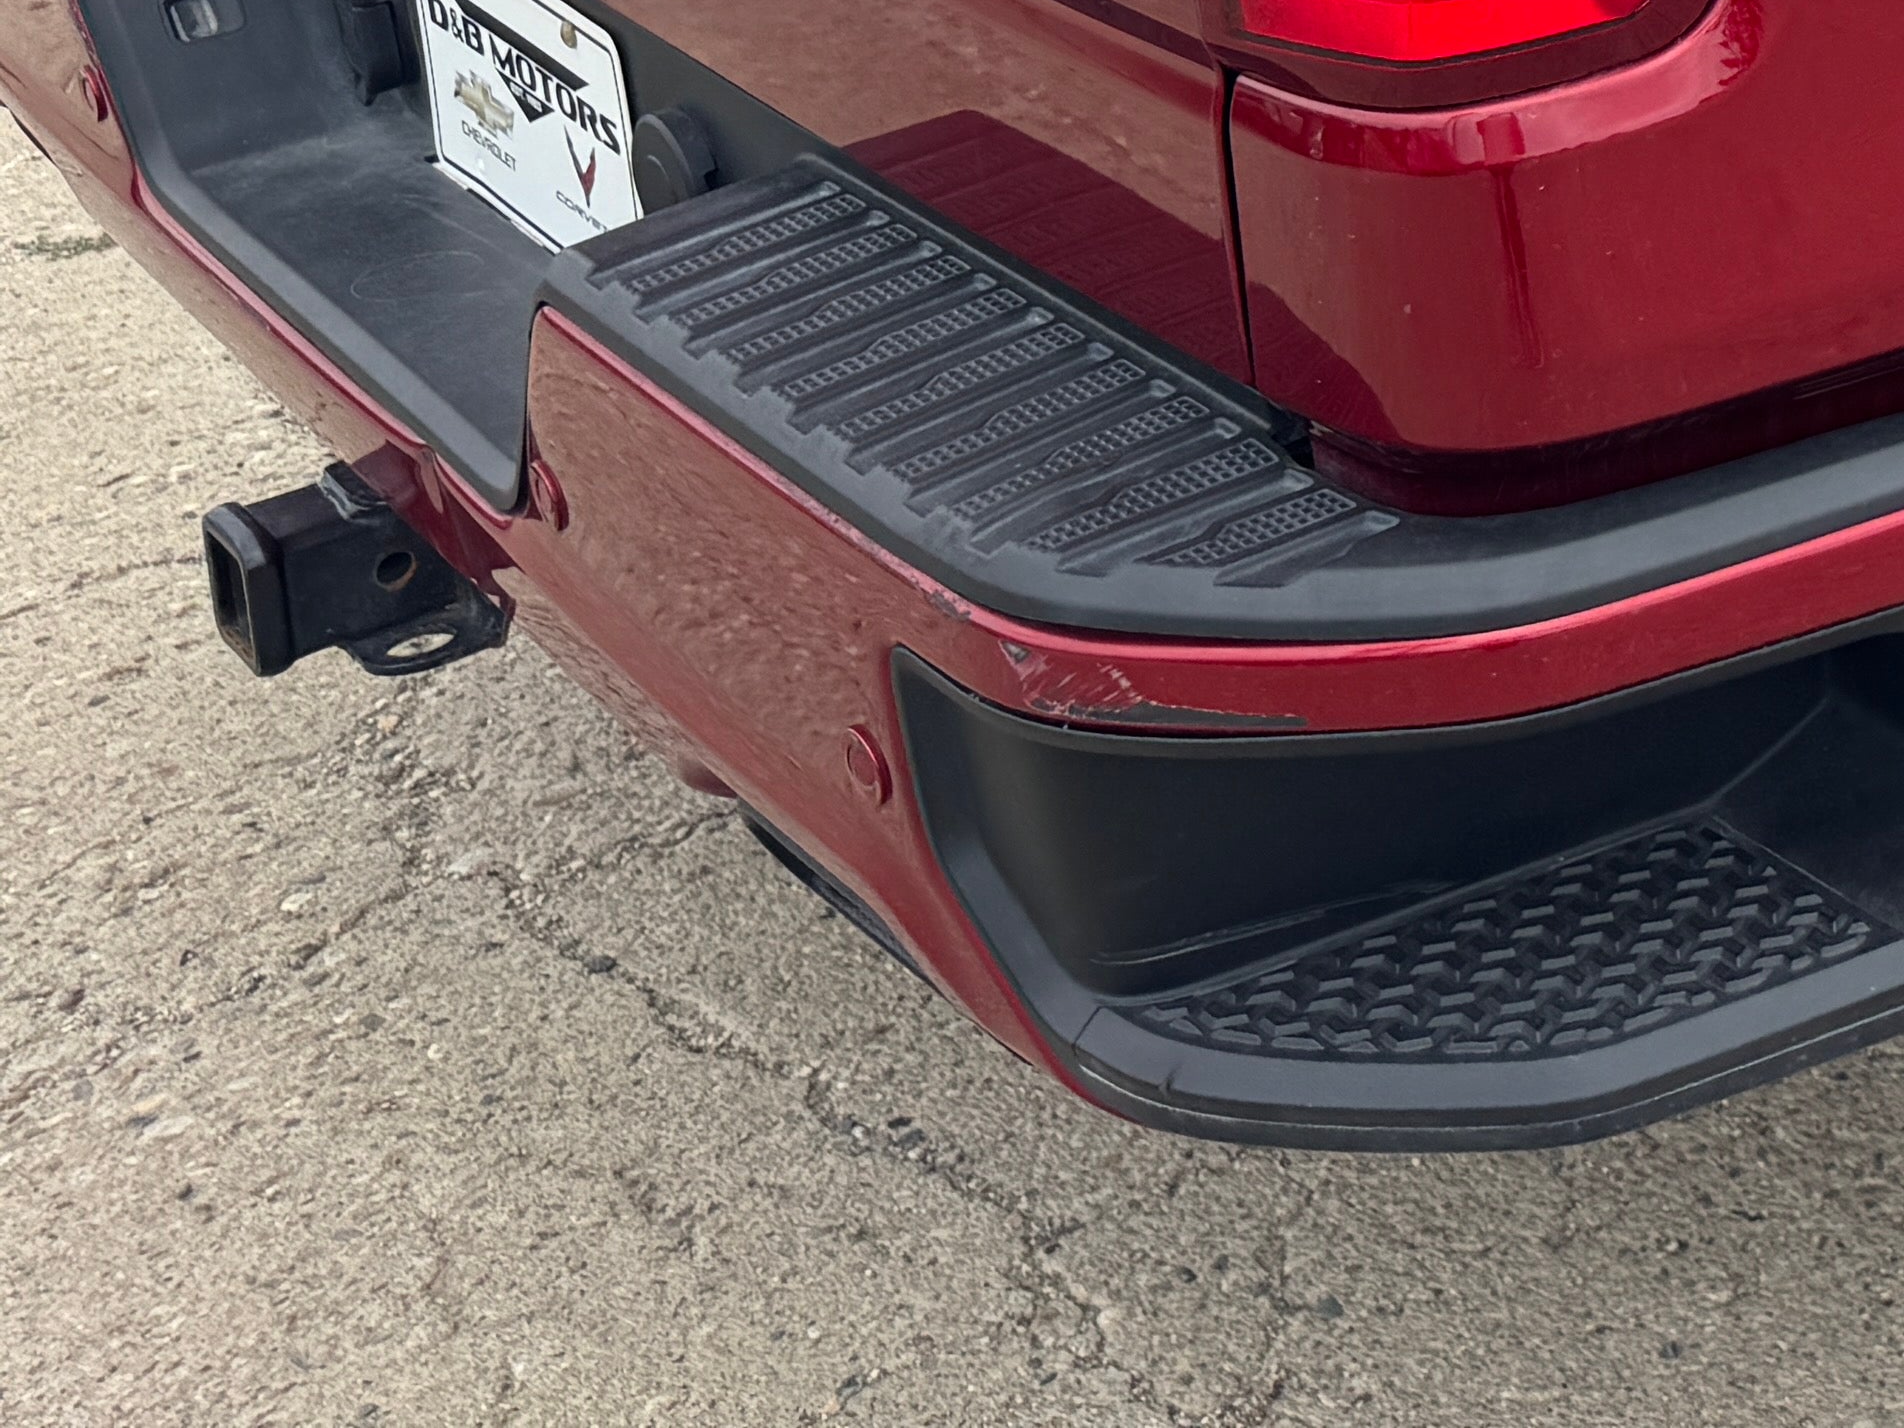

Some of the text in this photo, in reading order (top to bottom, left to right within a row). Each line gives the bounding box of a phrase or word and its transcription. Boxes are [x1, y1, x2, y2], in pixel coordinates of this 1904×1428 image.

[488, 30, 621, 156] MOTORS
[461, 119, 517, 173] CHEVROLET
[555, 189, 609, 234] CORVET
